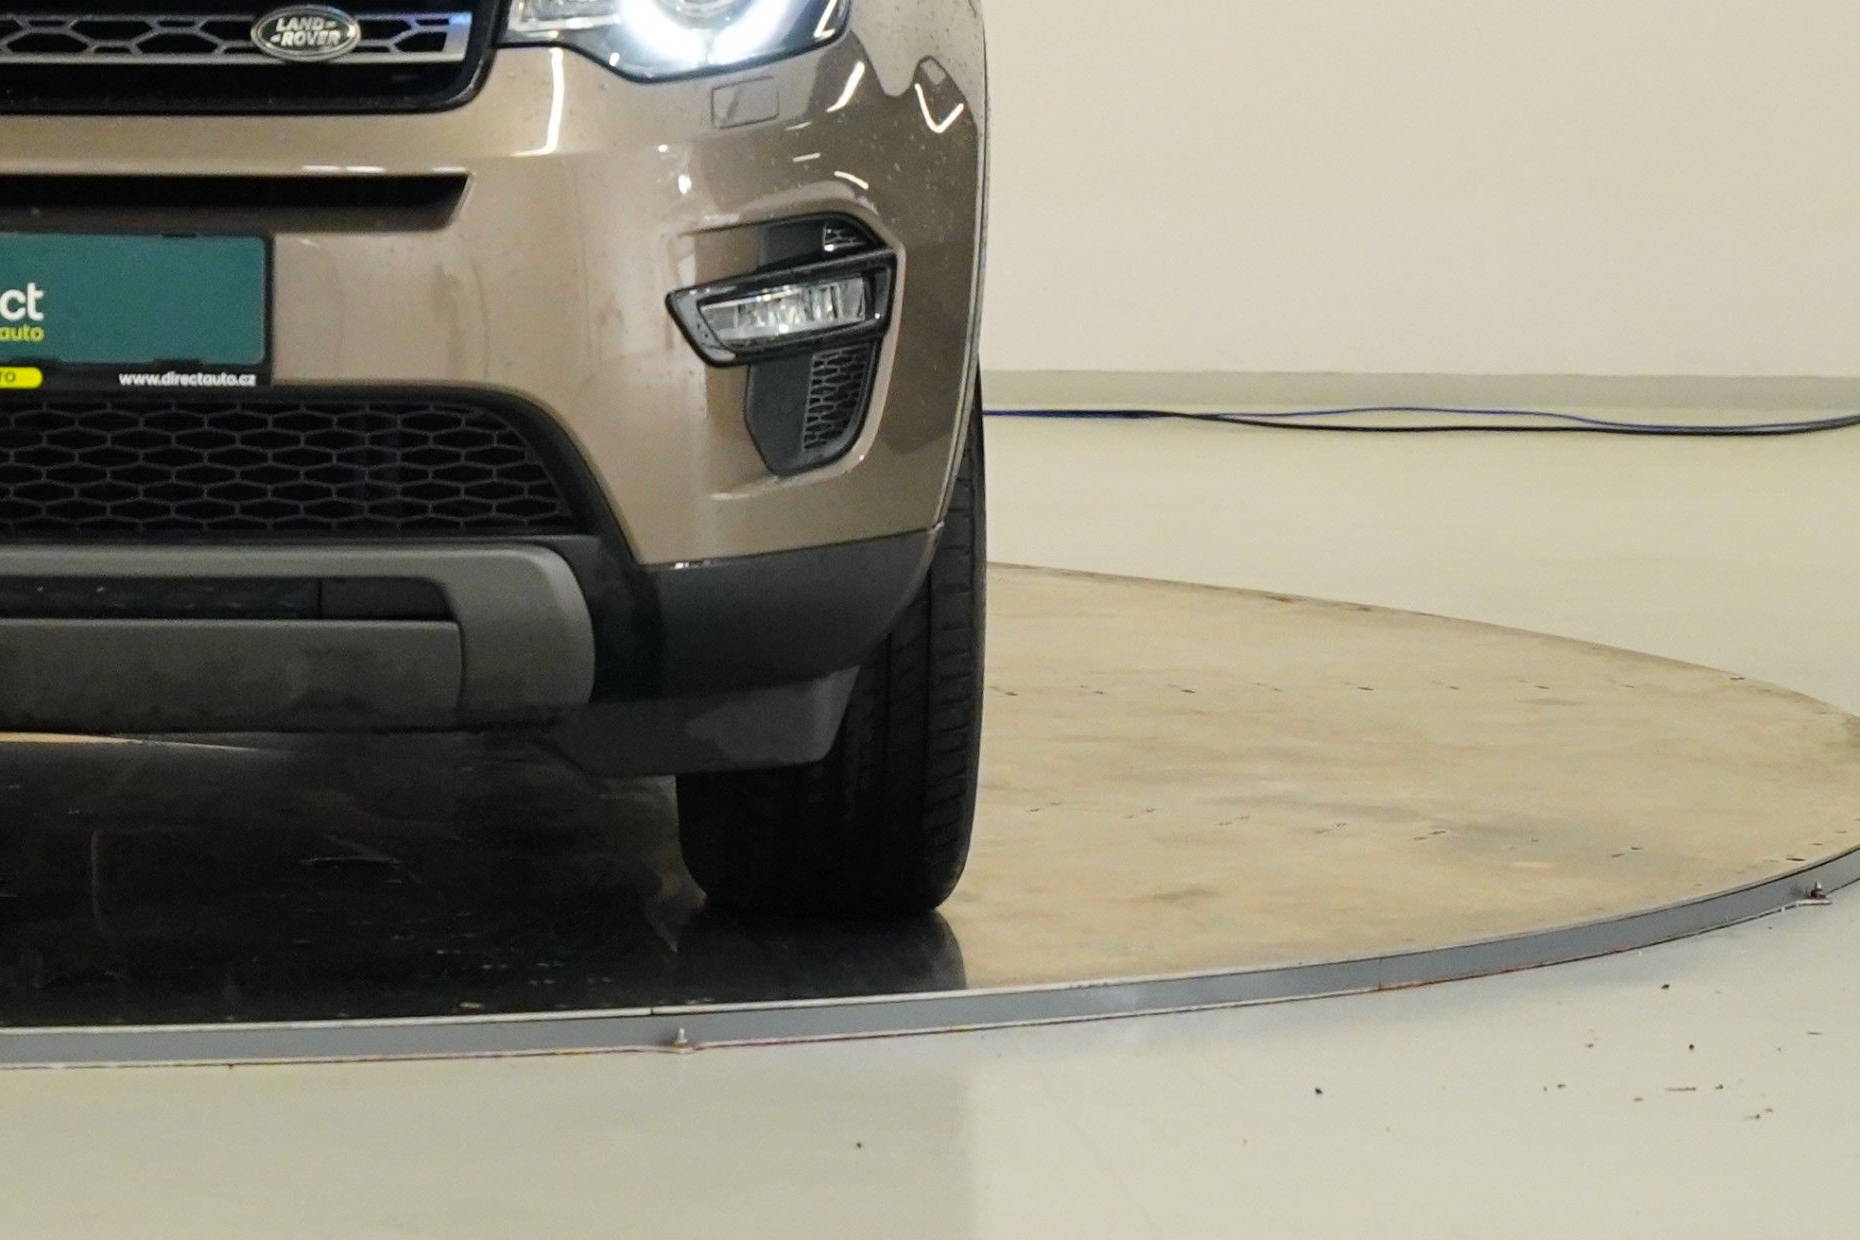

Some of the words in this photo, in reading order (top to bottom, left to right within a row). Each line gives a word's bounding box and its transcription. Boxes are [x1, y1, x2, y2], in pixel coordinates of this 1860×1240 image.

[276, 17, 325, 33] LAND
[281, 30, 341, 47] ROVER
[119, 370, 257, 387] www.directauto.cz
